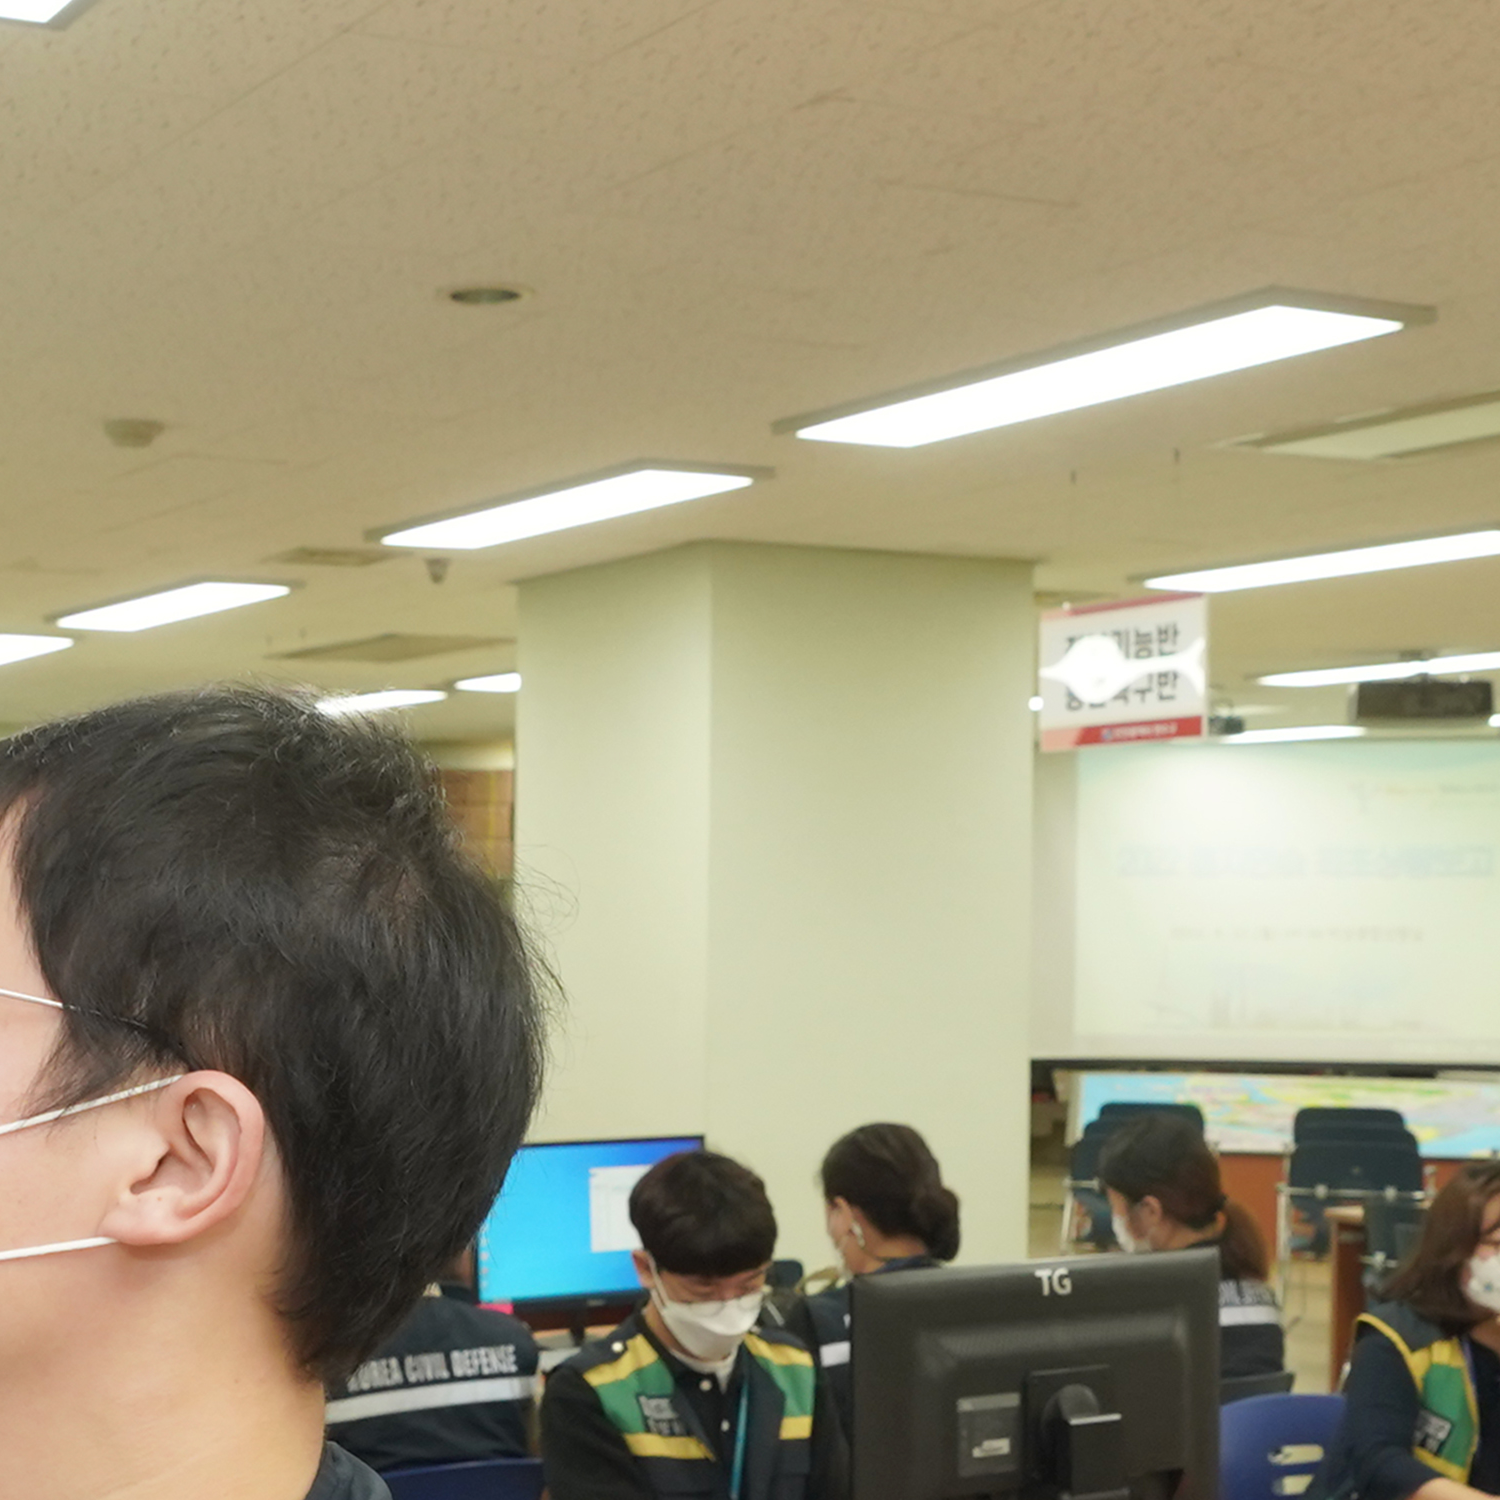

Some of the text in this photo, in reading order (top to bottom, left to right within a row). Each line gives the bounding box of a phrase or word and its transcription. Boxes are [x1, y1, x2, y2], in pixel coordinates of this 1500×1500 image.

[1034, 1267, 1072, 1296] TG
[404, 1352, 450, 1383] CIVIL
[450, 1344, 518, 1378] DEFENSE
